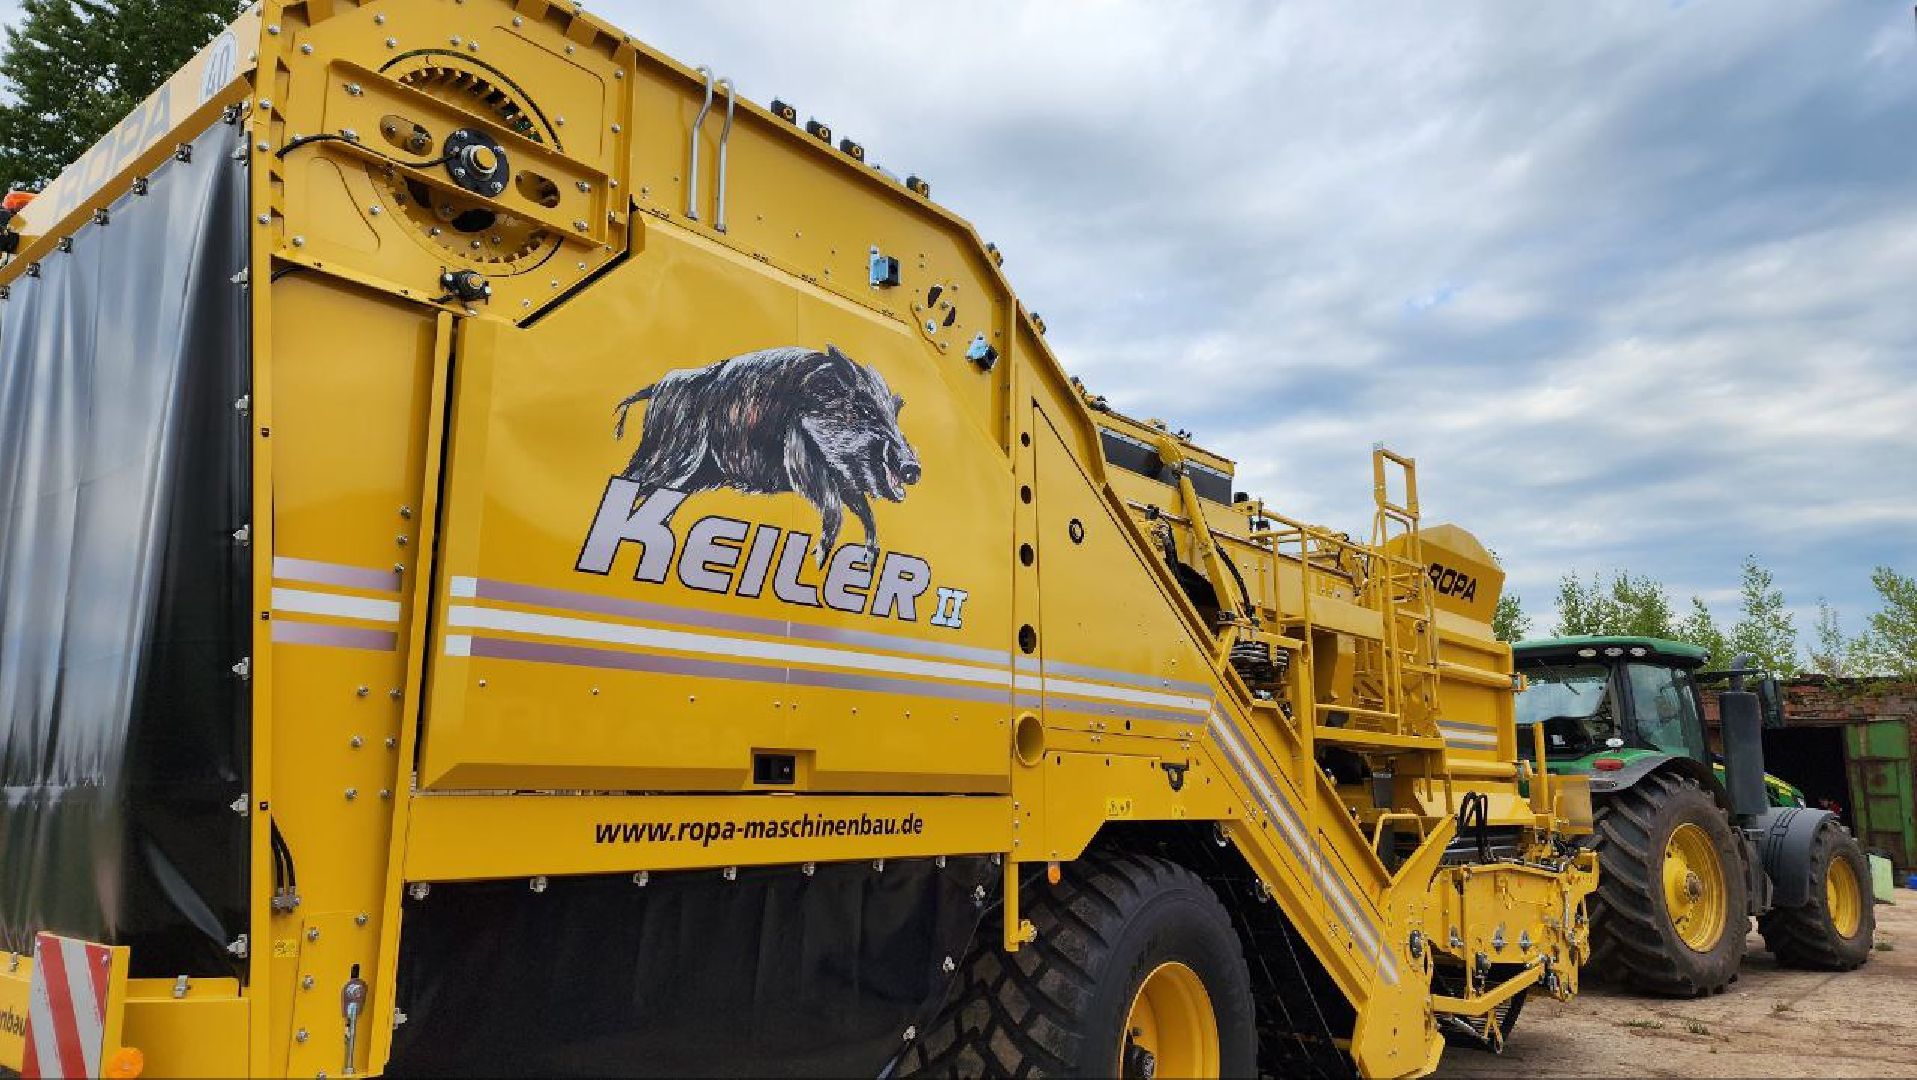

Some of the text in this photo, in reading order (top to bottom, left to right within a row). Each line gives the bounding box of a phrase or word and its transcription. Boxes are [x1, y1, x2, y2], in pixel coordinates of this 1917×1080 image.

[50, 82, 171, 218] ROPA
[575, 474, 968, 629] KEILER II
[1428, 562, 1477, 603] ROPA
[595, 813, 924, 847] www.ropa-maschinenbau.de
